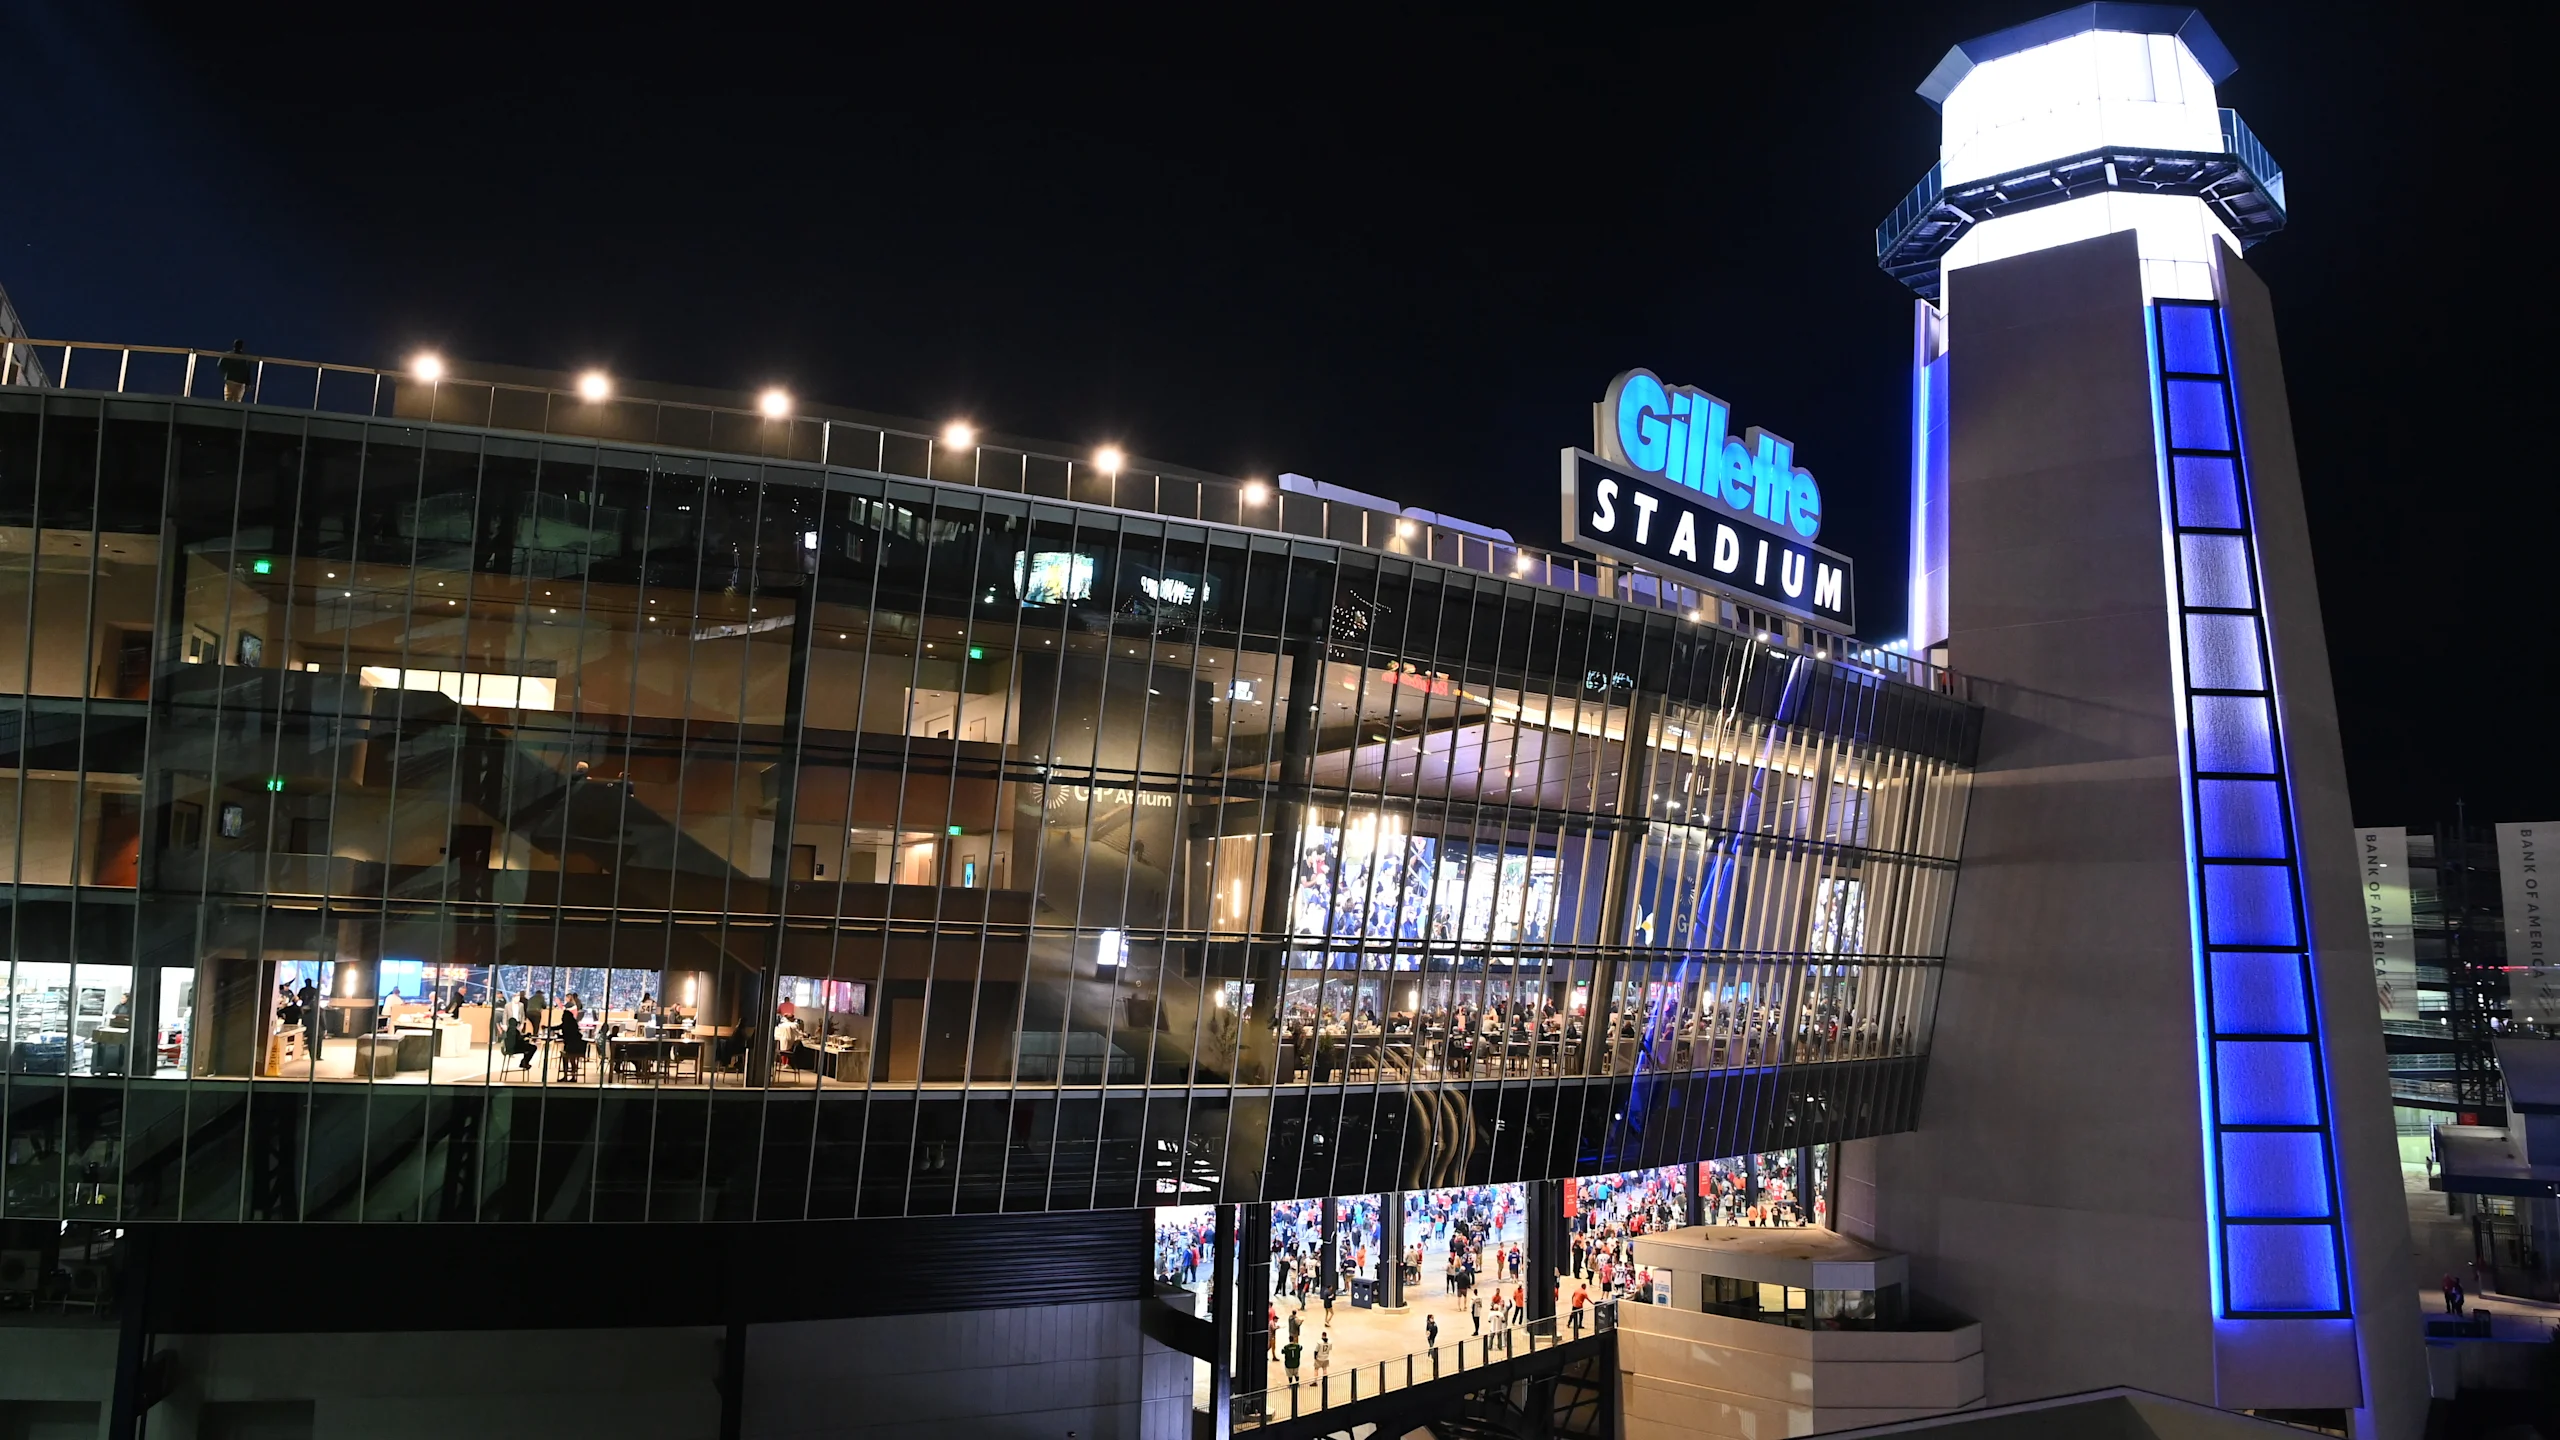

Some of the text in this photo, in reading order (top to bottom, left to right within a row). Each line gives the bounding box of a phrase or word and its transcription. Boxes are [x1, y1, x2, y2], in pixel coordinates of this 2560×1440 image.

[1618, 374, 1820, 537] Gillette
[1592, 478, 1843, 613] STADIUM
[1114, 788, 1172, 807] Atrium
[2366, 834, 2387, 978] BANK OF AMERICA
[2520, 829, 2545, 979] BANK OF AMERICA
